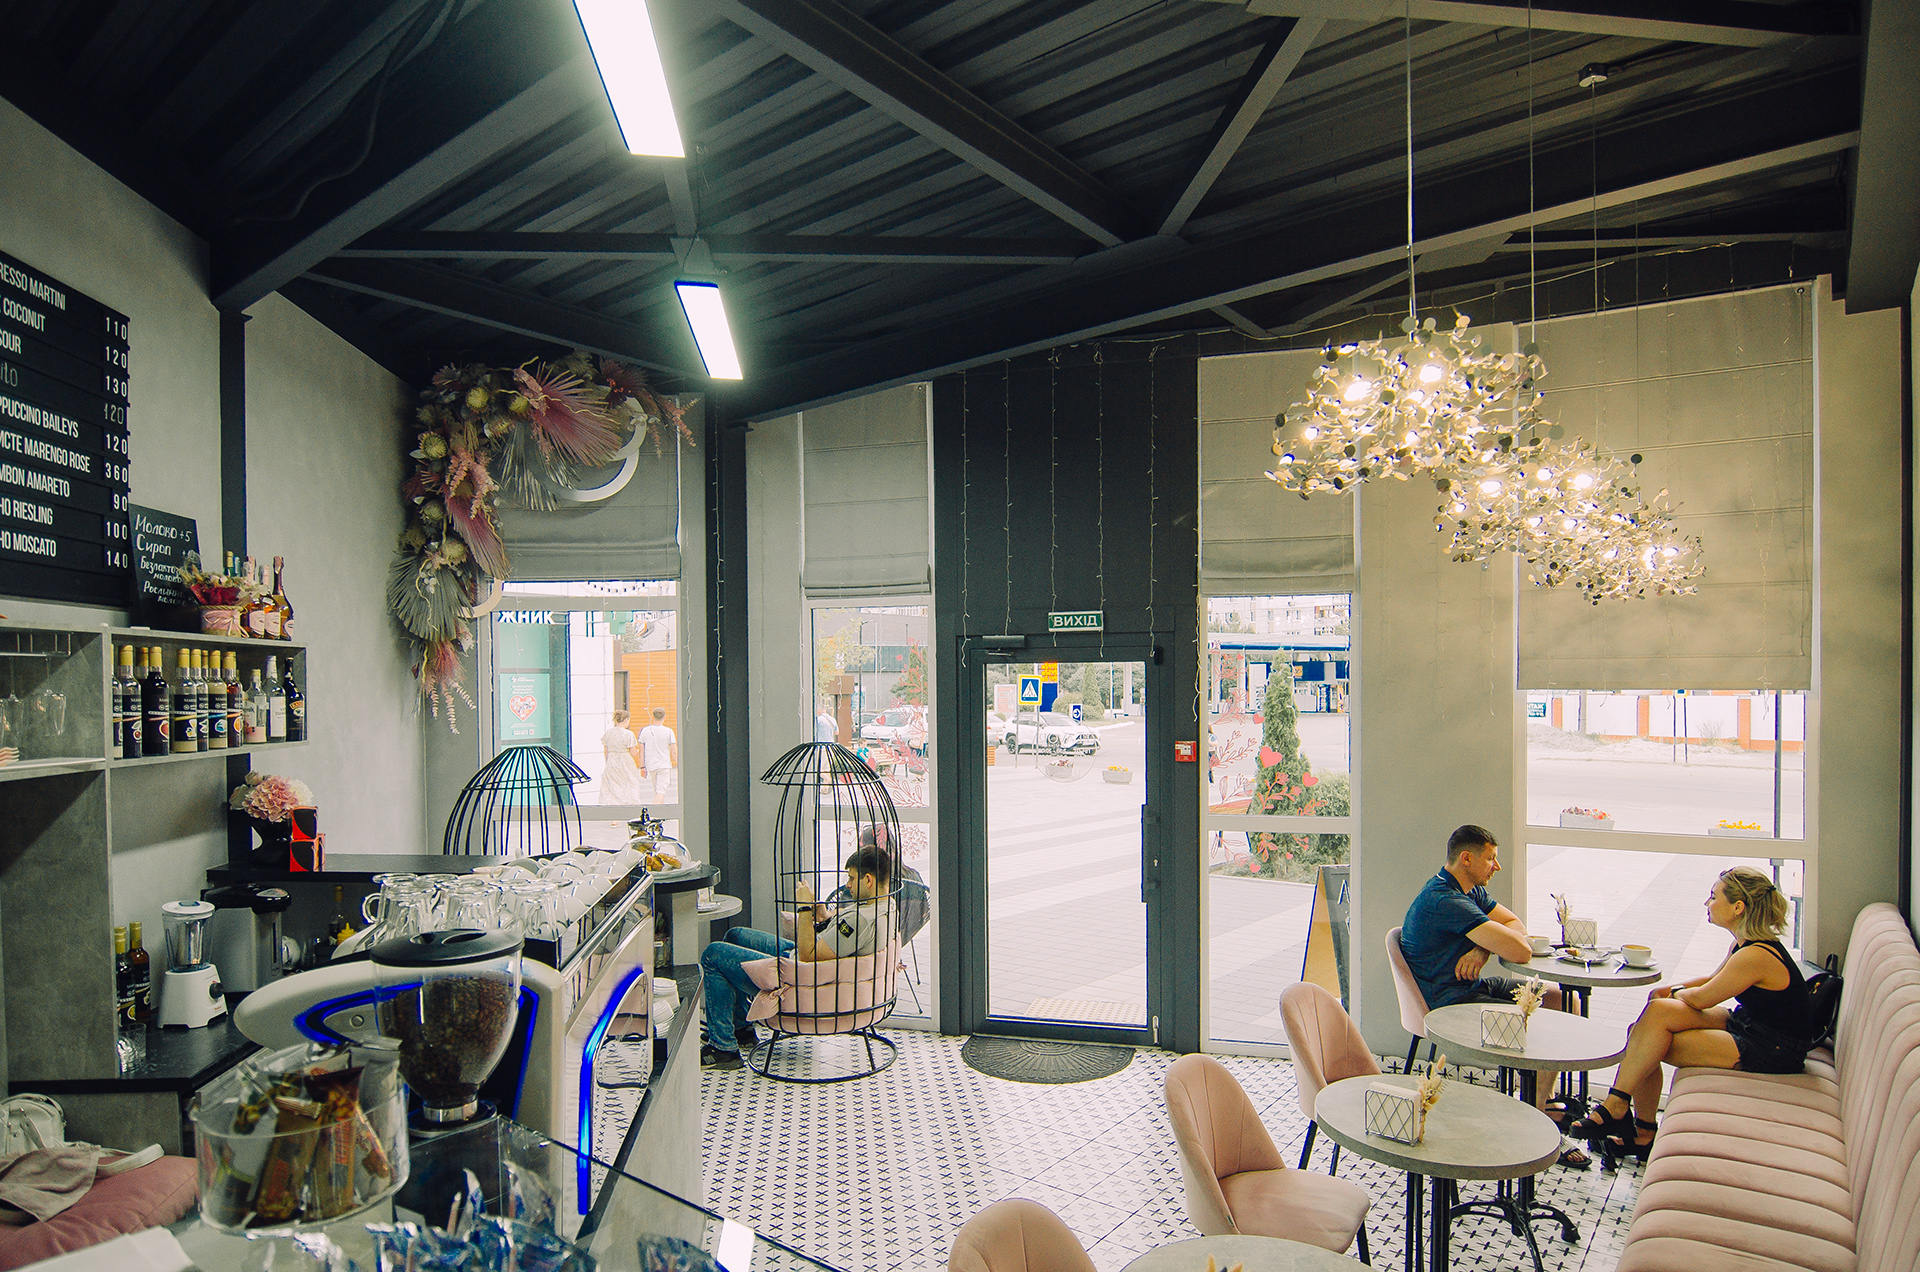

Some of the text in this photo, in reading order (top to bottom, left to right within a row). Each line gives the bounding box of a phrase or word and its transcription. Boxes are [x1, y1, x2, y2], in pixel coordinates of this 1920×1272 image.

[29, 277, 66, 311] MARTINI
[105, 316, 127, 340] 110
[3, 297, 127, 369] COCONUT 120
[105, 375, 127, 398] 130
[104, 402, 124, 424] 120
[42, 410, 79, 439] BAILEYS
[106, 433, 127, 455] 120
[24, 437, 68, 468] MARENGO
[69, 450, 91, 473] ROSE
[105, 462, 128, 484] 360
[27, 470, 70, 498] AMARETO
[113, 493, 128, 512] 90
[13, 499, 53, 526] RIESLING
[106, 521, 128, 540] 100
[135, 514, 178, 539] Молоко
[13, 532, 57, 558] MOSCATO
[106, 550, 128, 569] 140
[136, 533, 172, 559] Сироп
[499, 611, 555, 625] ЖНИК
[1053, 615, 1098, 627] ВИХІД
